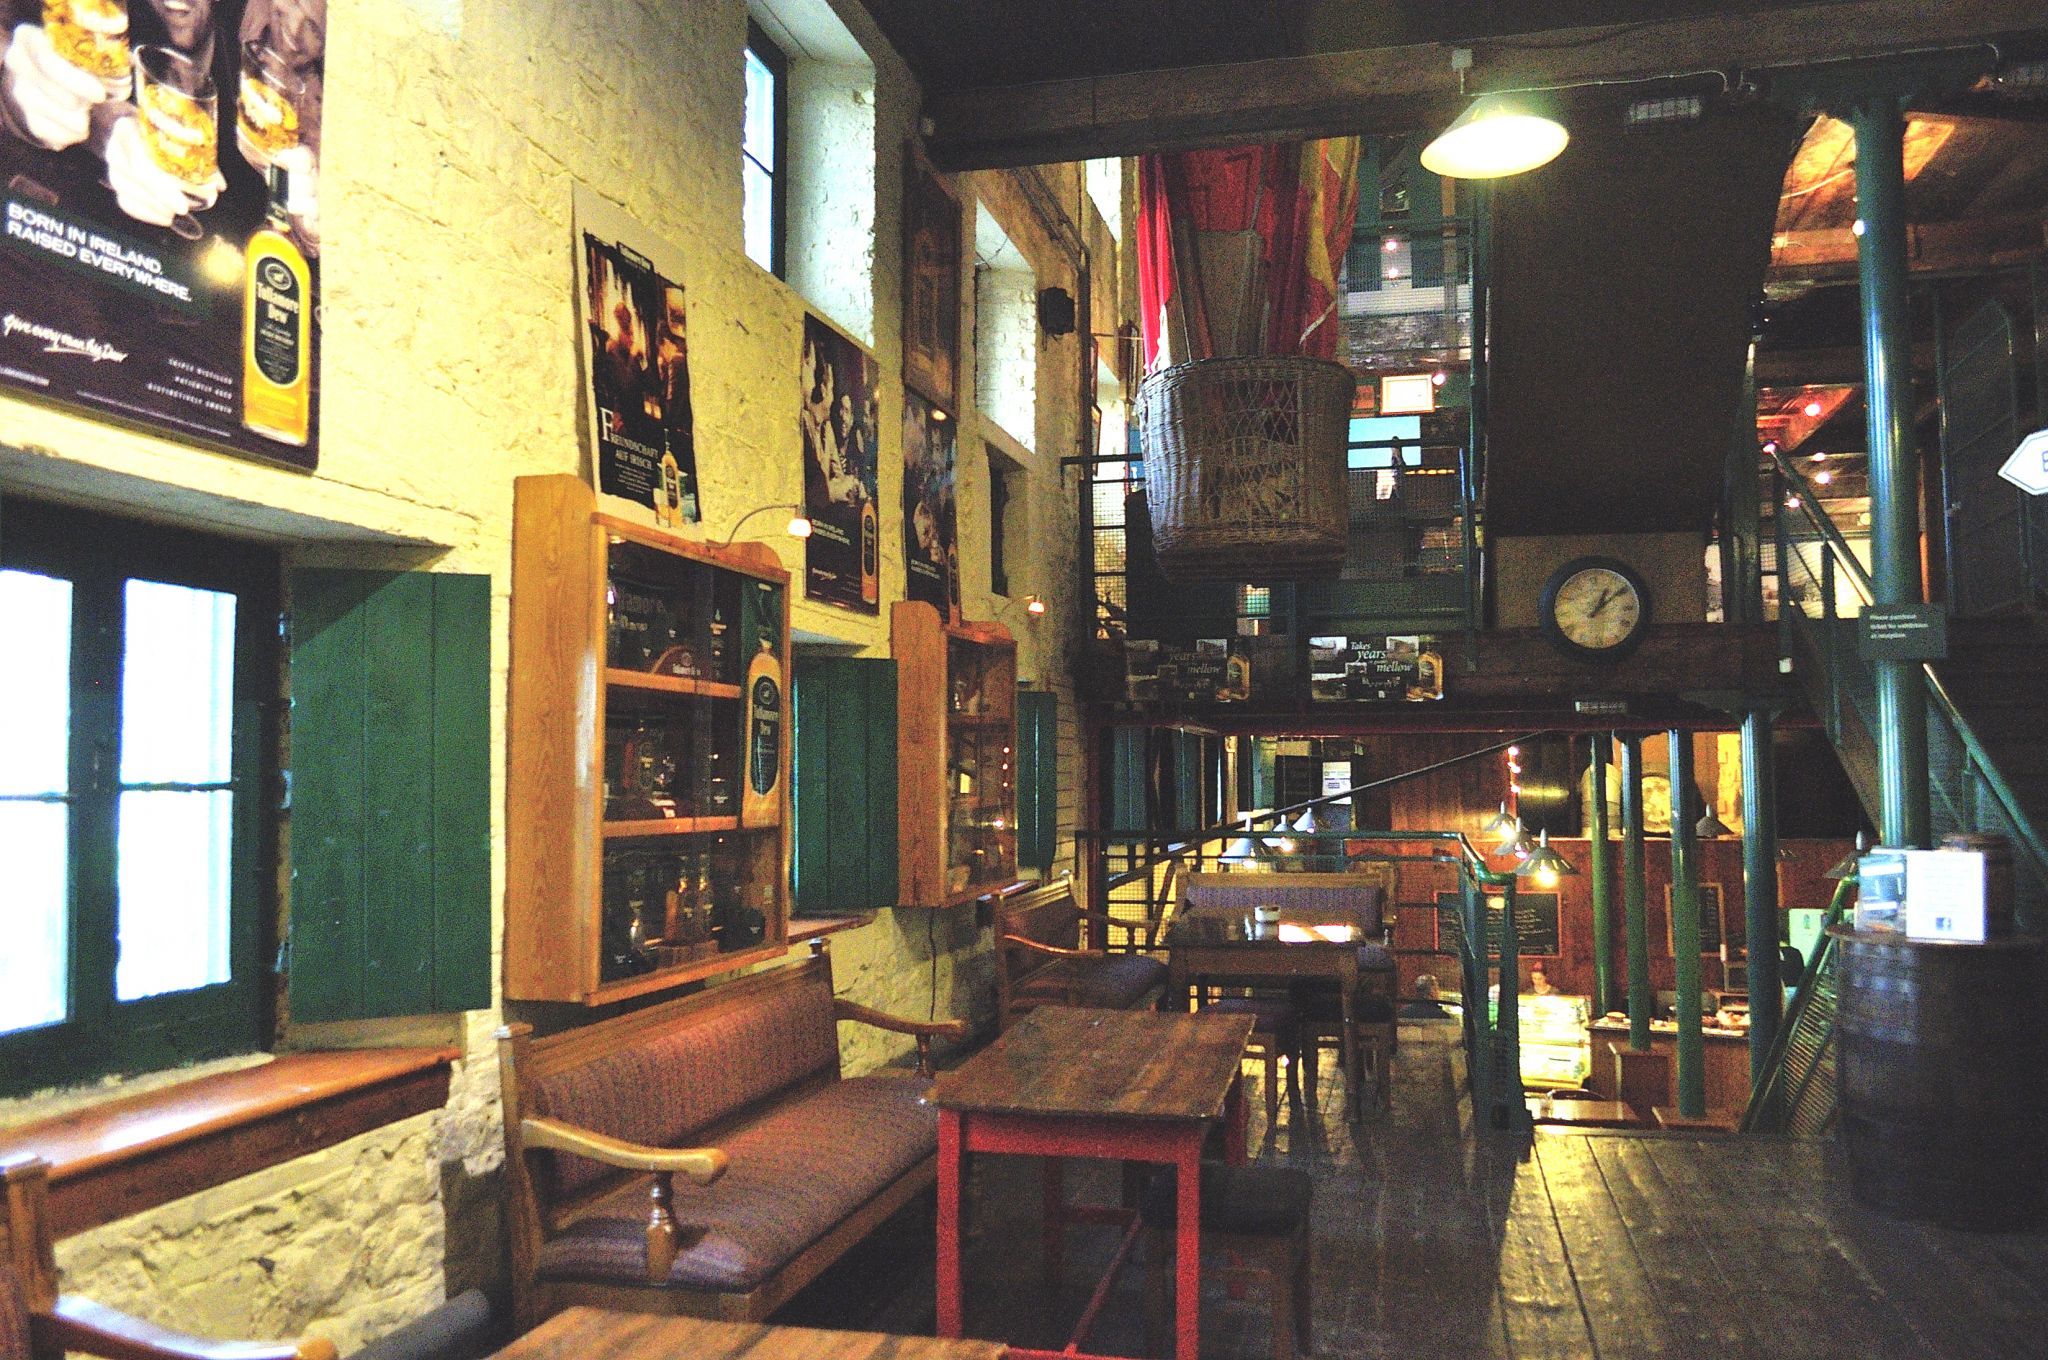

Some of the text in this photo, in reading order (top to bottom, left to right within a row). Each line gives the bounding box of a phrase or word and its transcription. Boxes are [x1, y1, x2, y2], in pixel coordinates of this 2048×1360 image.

[8, 202, 64, 236] BORN
[68, 226, 87, 245] IN
[8, 220, 192, 302] RAISED EVERYWHERE.
[1357, 650, 1387, 664] years
[1376, 660, 1413, 674] mellow
